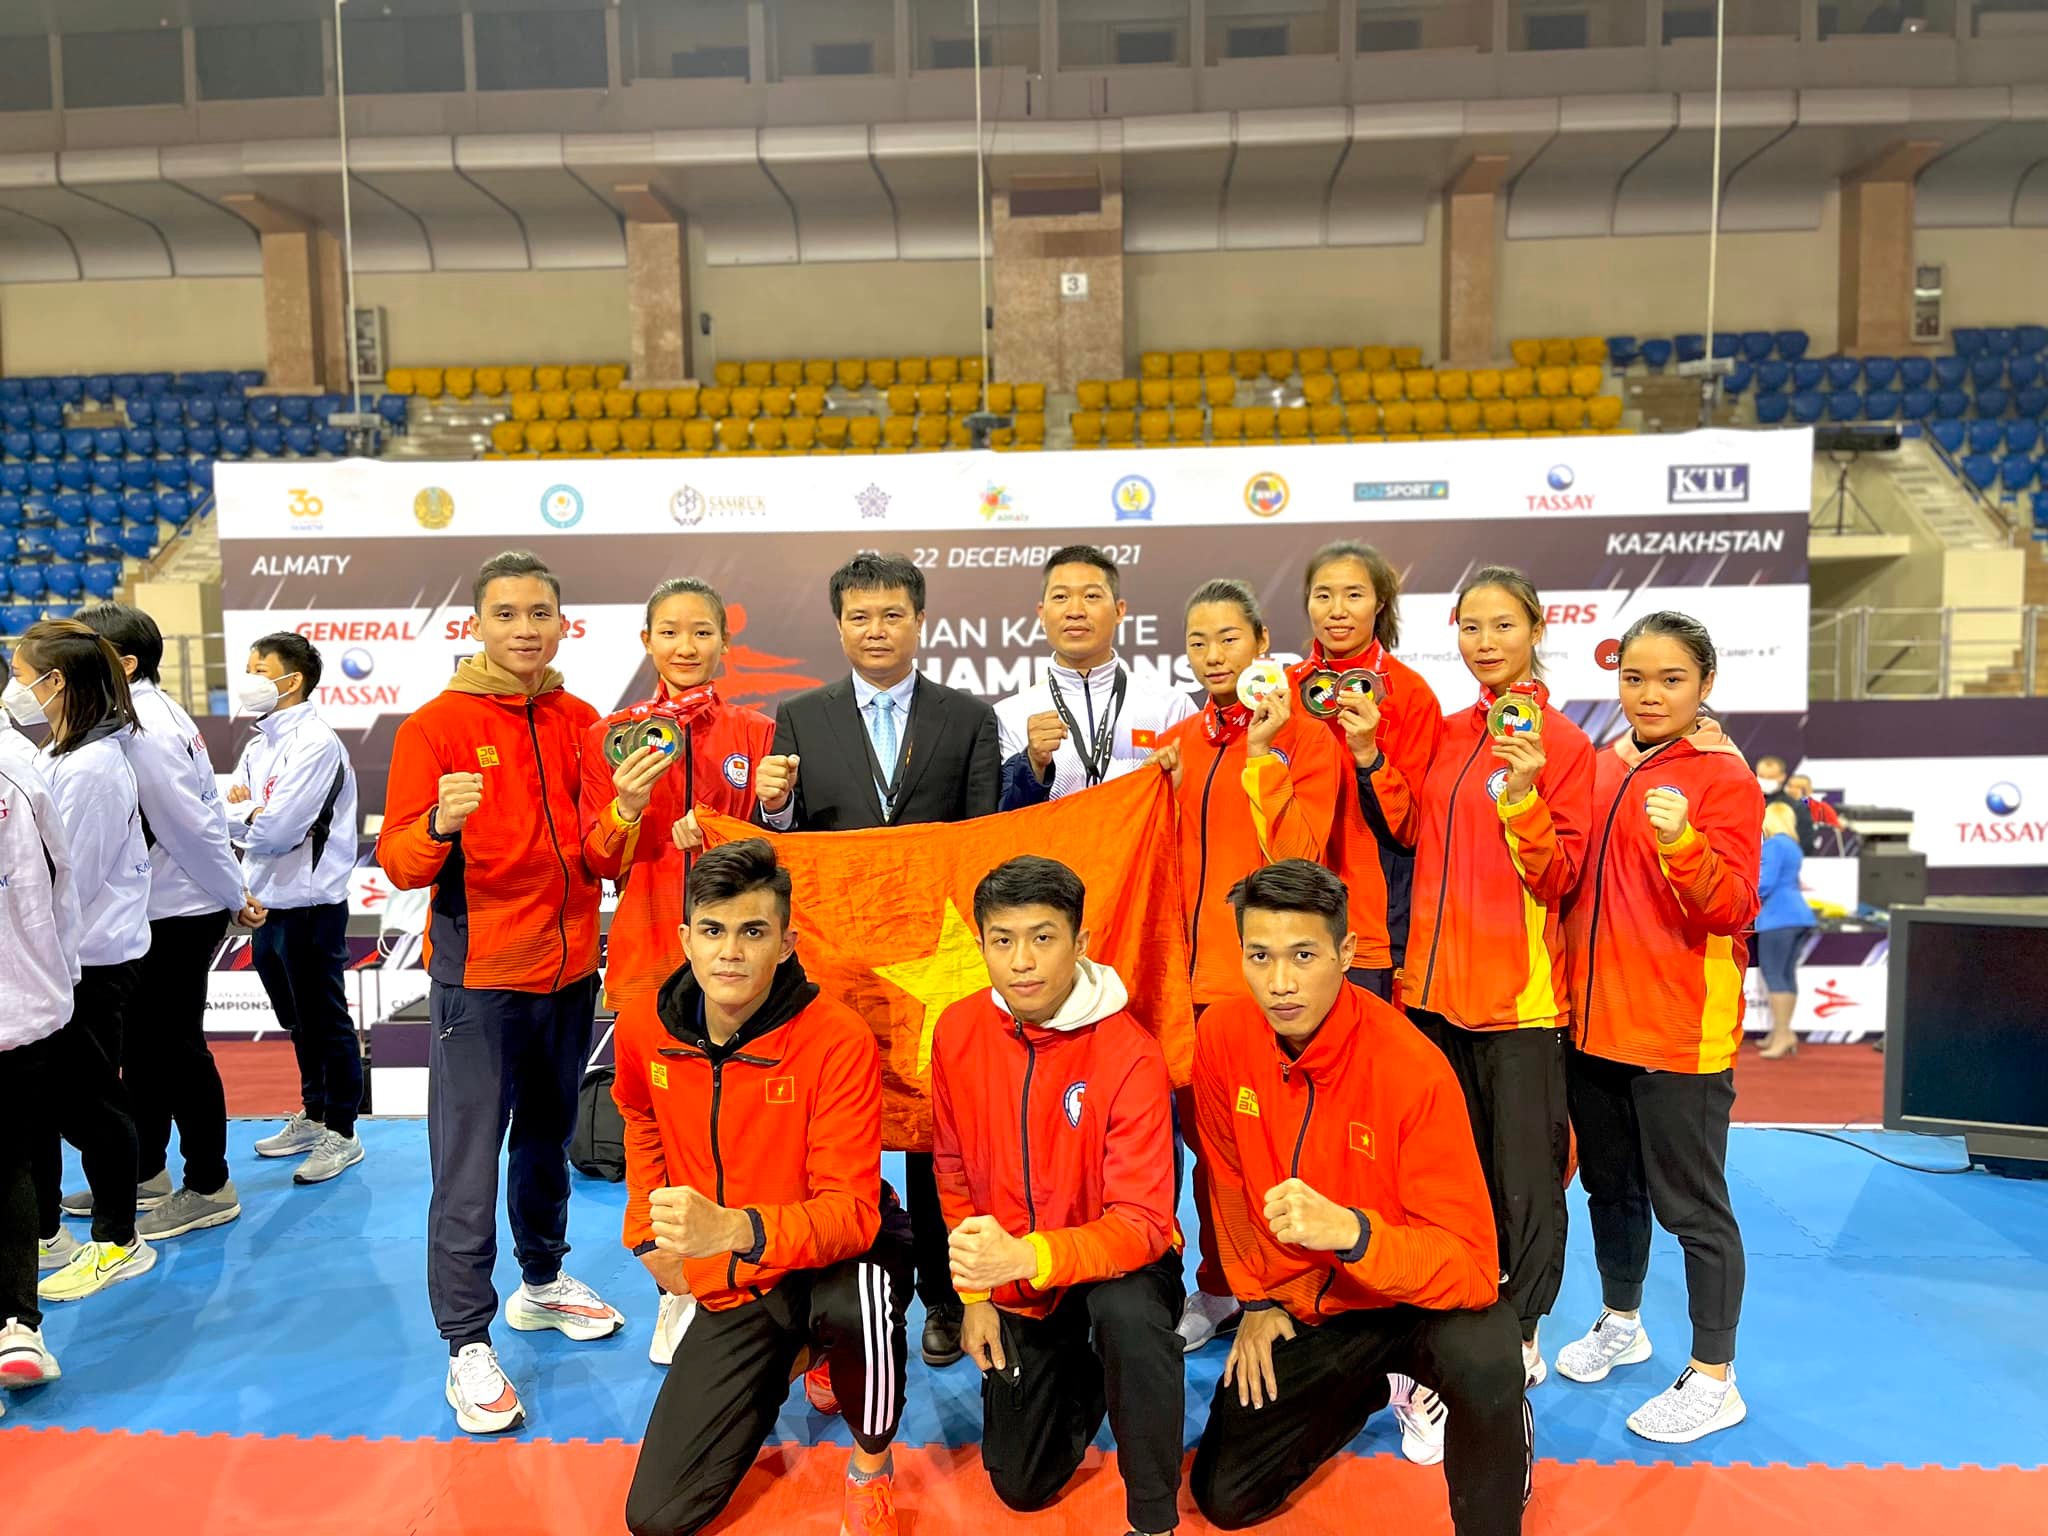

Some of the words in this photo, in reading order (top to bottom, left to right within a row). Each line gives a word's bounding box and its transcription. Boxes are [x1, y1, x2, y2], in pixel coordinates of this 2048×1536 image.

[1066, 276, 1080, 293] 3
[1673, 467, 1746, 493] KTL
[288, 488, 324, 517] 30
[1526, 494, 1595, 511] TASSAY
[1606, 530, 1784, 555] KAZAKHSTAN
[250, 554, 351, 576] ALMATY
[912, 547, 939, 568] 22
[295, 621, 417, 641] GENERAL
[1001, 614, 1159, 648] KATE
[317, 686, 401, 705] TASSAY
[1956, 821, 2048, 843] TASSAY
